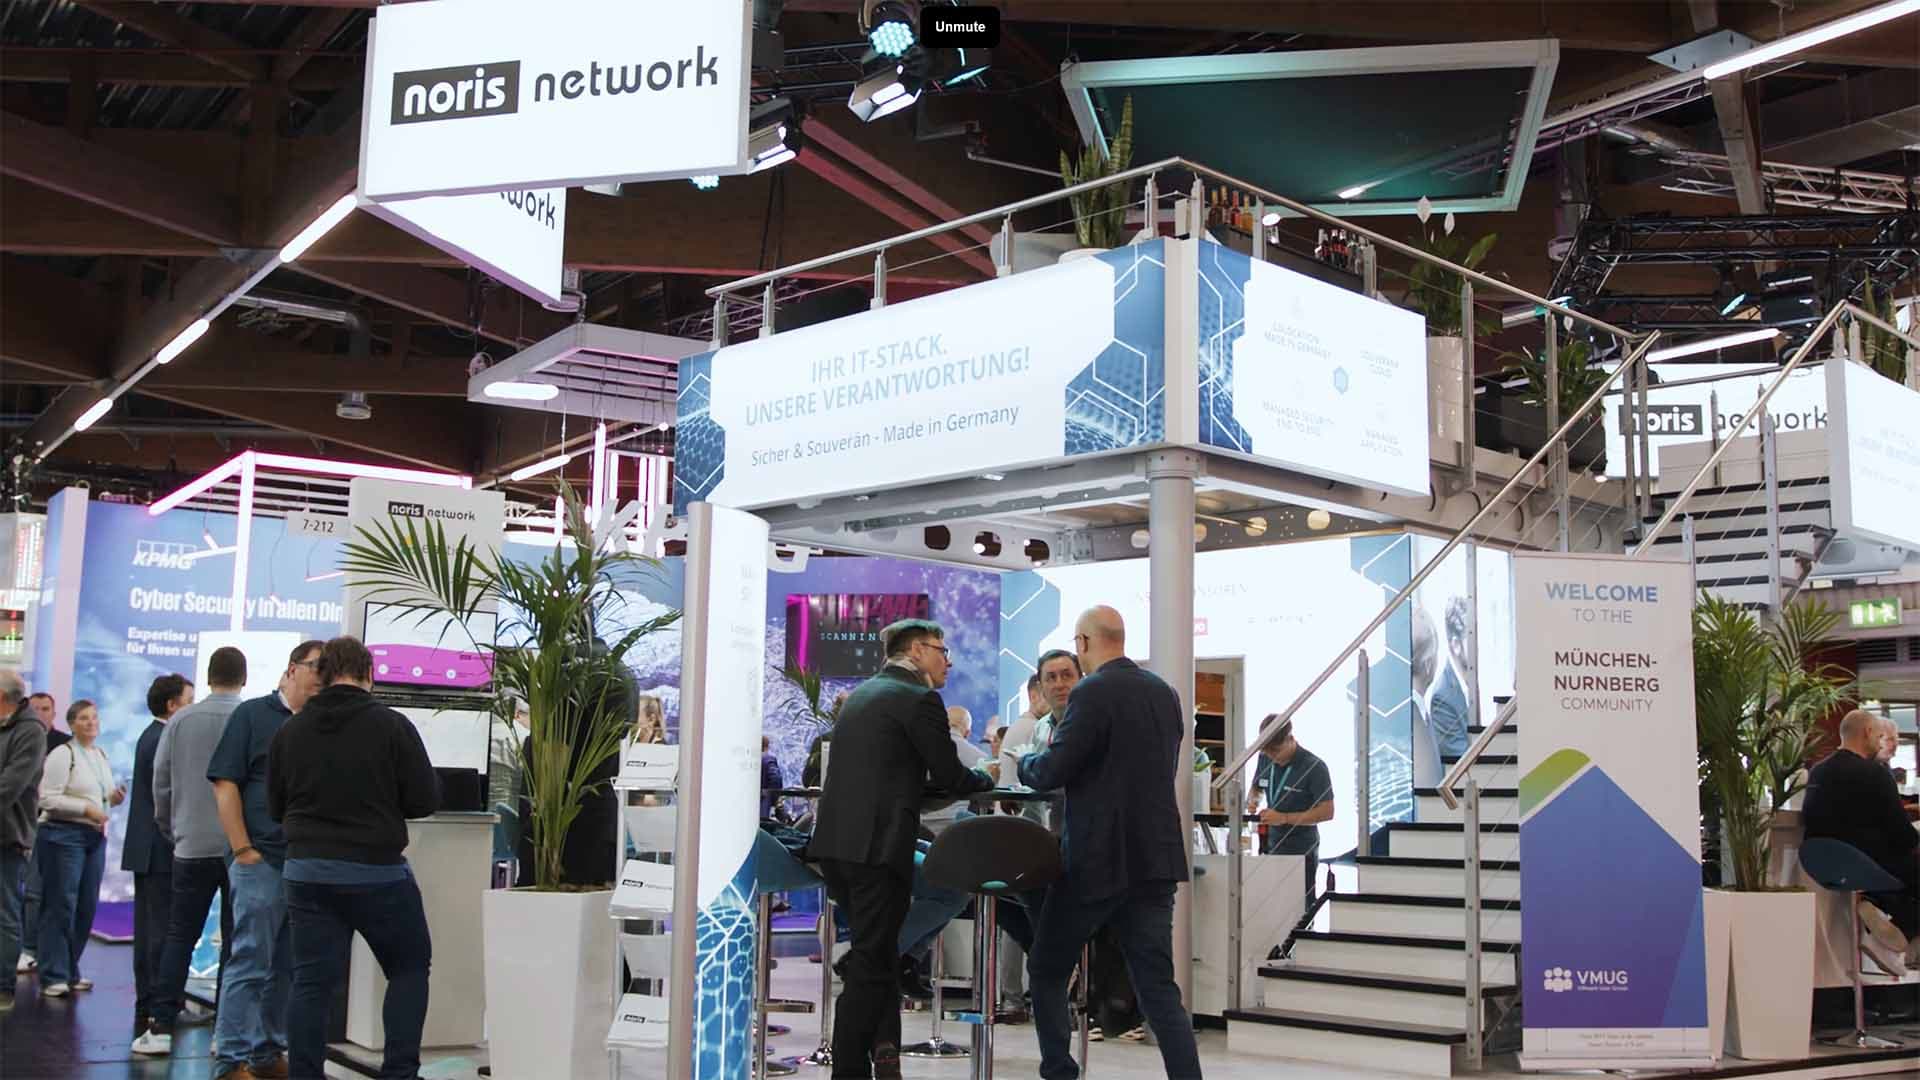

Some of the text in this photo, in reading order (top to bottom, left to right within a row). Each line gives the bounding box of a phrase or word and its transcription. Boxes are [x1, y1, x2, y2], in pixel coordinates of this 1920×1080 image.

[401, 44, 720, 118] noris network
[811, 333, 948, 384] IHR IT-STACK.
[745, 346, 1030, 427] UNSERE VERANTWORTUNG!
[1716, 405, 1828, 431] neork
[751, 448, 790, 467] Sicher
[793, 443, 802, 459] &
[883, 420, 924, 444] Made
[928, 416, 942, 436] in
[946, 405, 1019, 432] Germany
[390, 502, 476, 521] noris network
[303, 519, 335, 534] 7-212
[132, 551, 192, 570] KPMG
[1545, 581, 1658, 603] WELCOME
[129, 586, 182, 612] Cyber
[183, 590, 257, 619] Secury
[1573, 607, 1633, 624] TO THE
[127, 626, 186, 642] Expertise
[126, 641, 146, 655] für
[147, 643, 181, 656] Ihren
[1554, 648, 1657, 669] MÜNCHEN-
[1553, 674, 1660, 693] NURNBERG
[1560, 697, 1654, 712] COMMUNITY
[1576, 970, 1629, 985] VMUG
